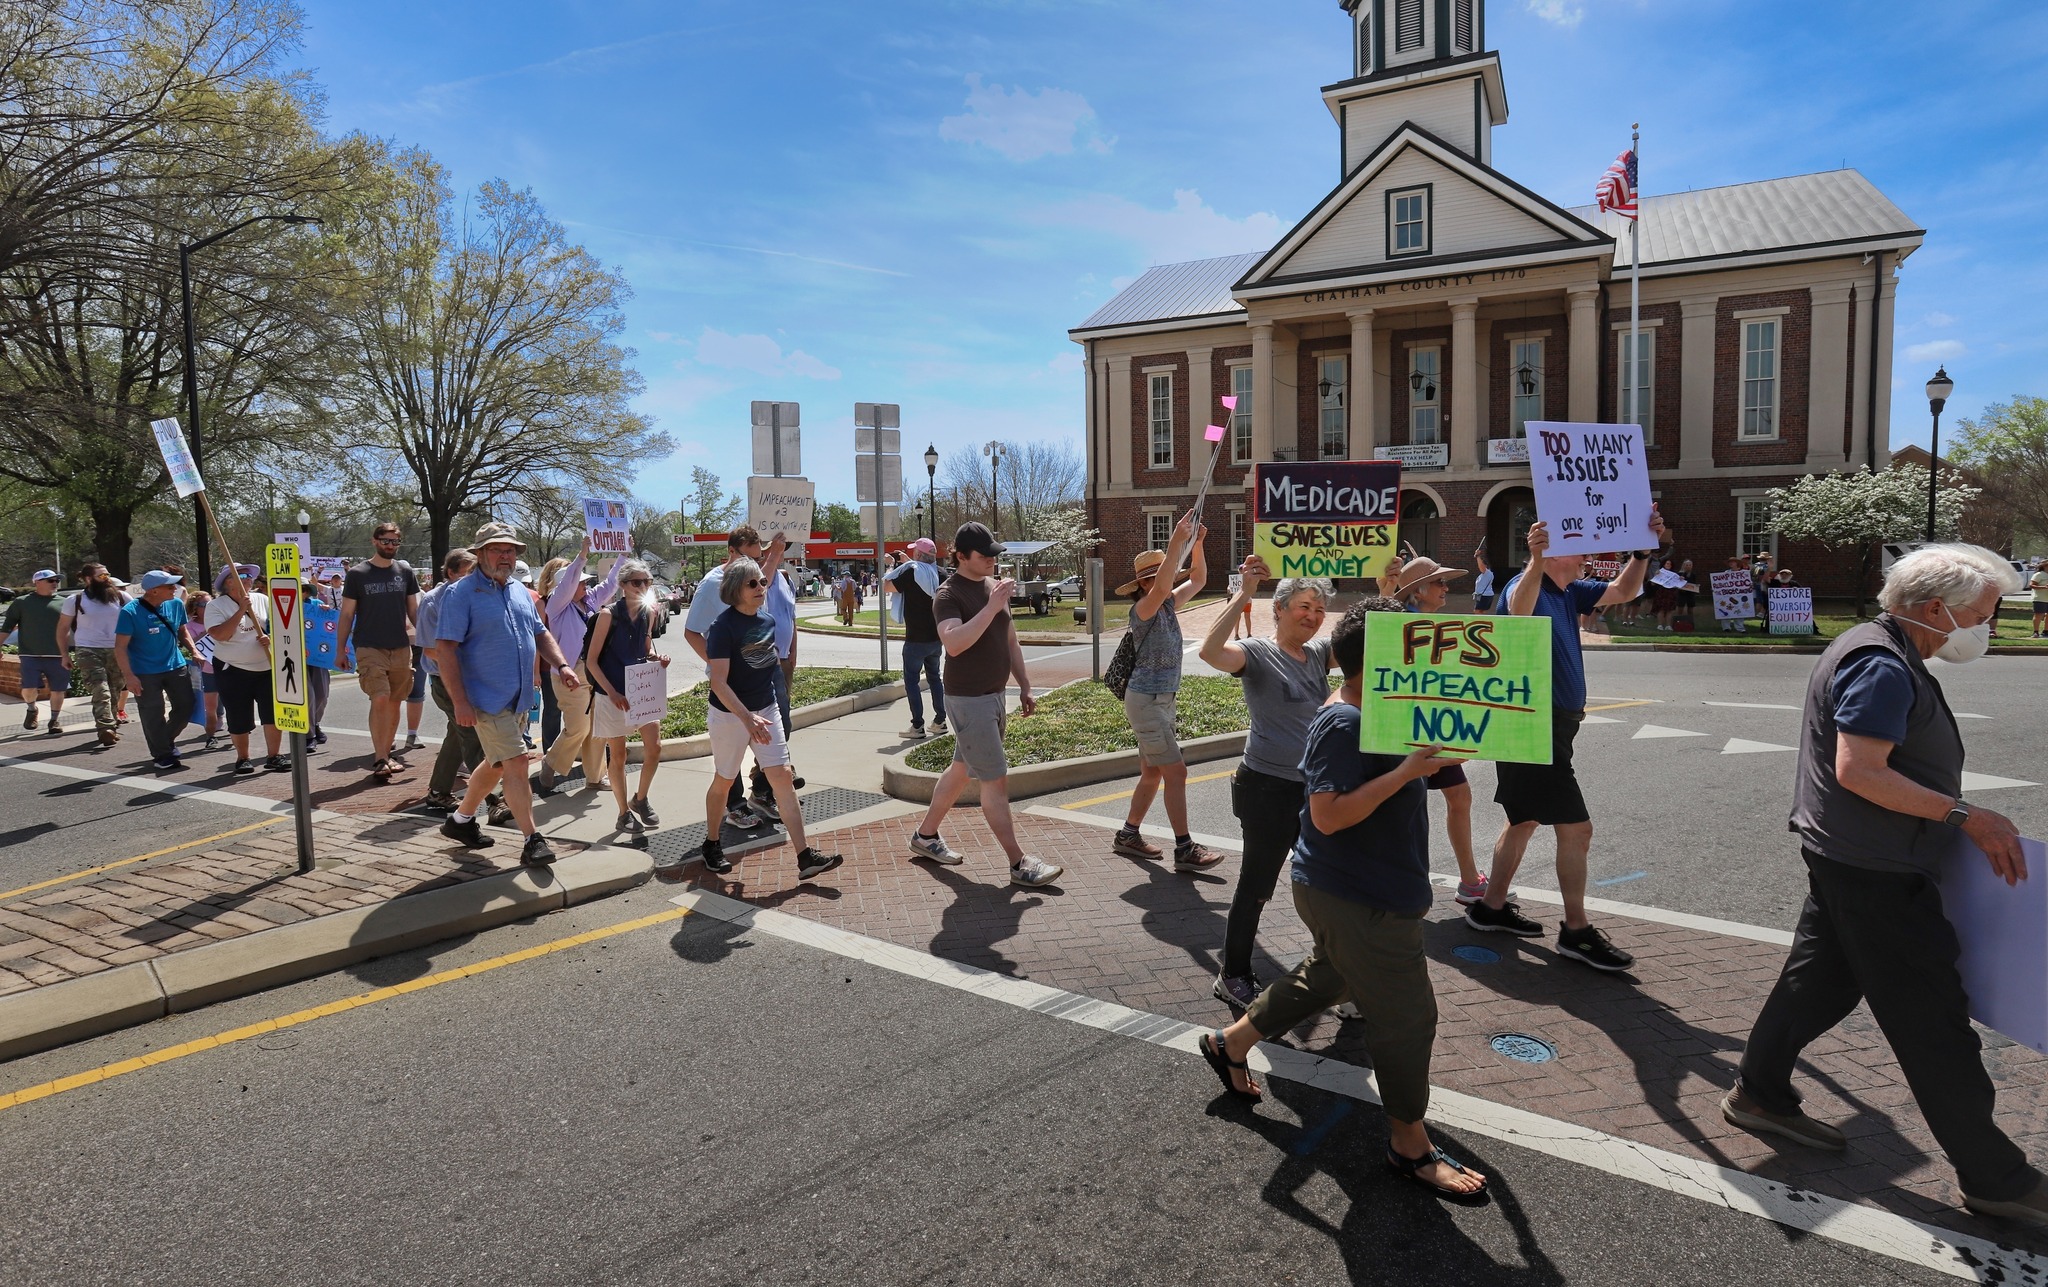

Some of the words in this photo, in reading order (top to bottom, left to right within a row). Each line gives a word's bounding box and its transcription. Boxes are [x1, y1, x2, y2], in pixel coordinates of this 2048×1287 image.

[1304, 286, 1386, 303] CHATHAM
[1400, 275, 1474, 292] COUNTY
[1491, 269, 1526, 282] 1770
[1539, 431, 1571, 456] TOO
[1583, 434, 1633, 454] MANY
[1553, 455, 1619, 482] ISSUES
[758, 492, 811, 507] IMPEACHMENT
[1584, 486, 1604, 506] for
[585, 499, 604, 518] VOTERS
[1561, 517, 1584, 531] one
[1595, 503, 1628, 534] sign!
[758, 520, 767, 531] IS
[769, 521, 780, 530] OK
[782, 521, 798, 530] WITH
[798, 522, 808, 531] ME
[674, 536, 693, 545] Exxon
[1271, 523, 1336, 548] SAVES
[271, 548, 293, 560] STATE
[1314, 548, 1344, 560] AND
[275, 563, 291, 575] LAW
[1282, 554, 1371, 577] MONEY
[1594, 561, 1620, 569] HANDS
[1713, 573, 1730, 581] DUMP
[1731, 572, 1746, 580] RFK
[1735, 579, 1751, 587] CDC
[1769, 588, 1810, 599] RESTORE
[1769, 601, 1812, 611] DIVERSITY
[1769, 612, 1810, 622] EQUITY
[1770, 625, 1813, 634] INCLUSION
[283, 635, 291, 644] TO
[1403, 620, 1500, 668] FFS
[1372, 667, 1532, 705] IMPEACH
[283, 707, 300, 717] WITHIN
[277, 717, 306, 729] CROSSWALK
[1412, 705, 1491, 743] NOW
